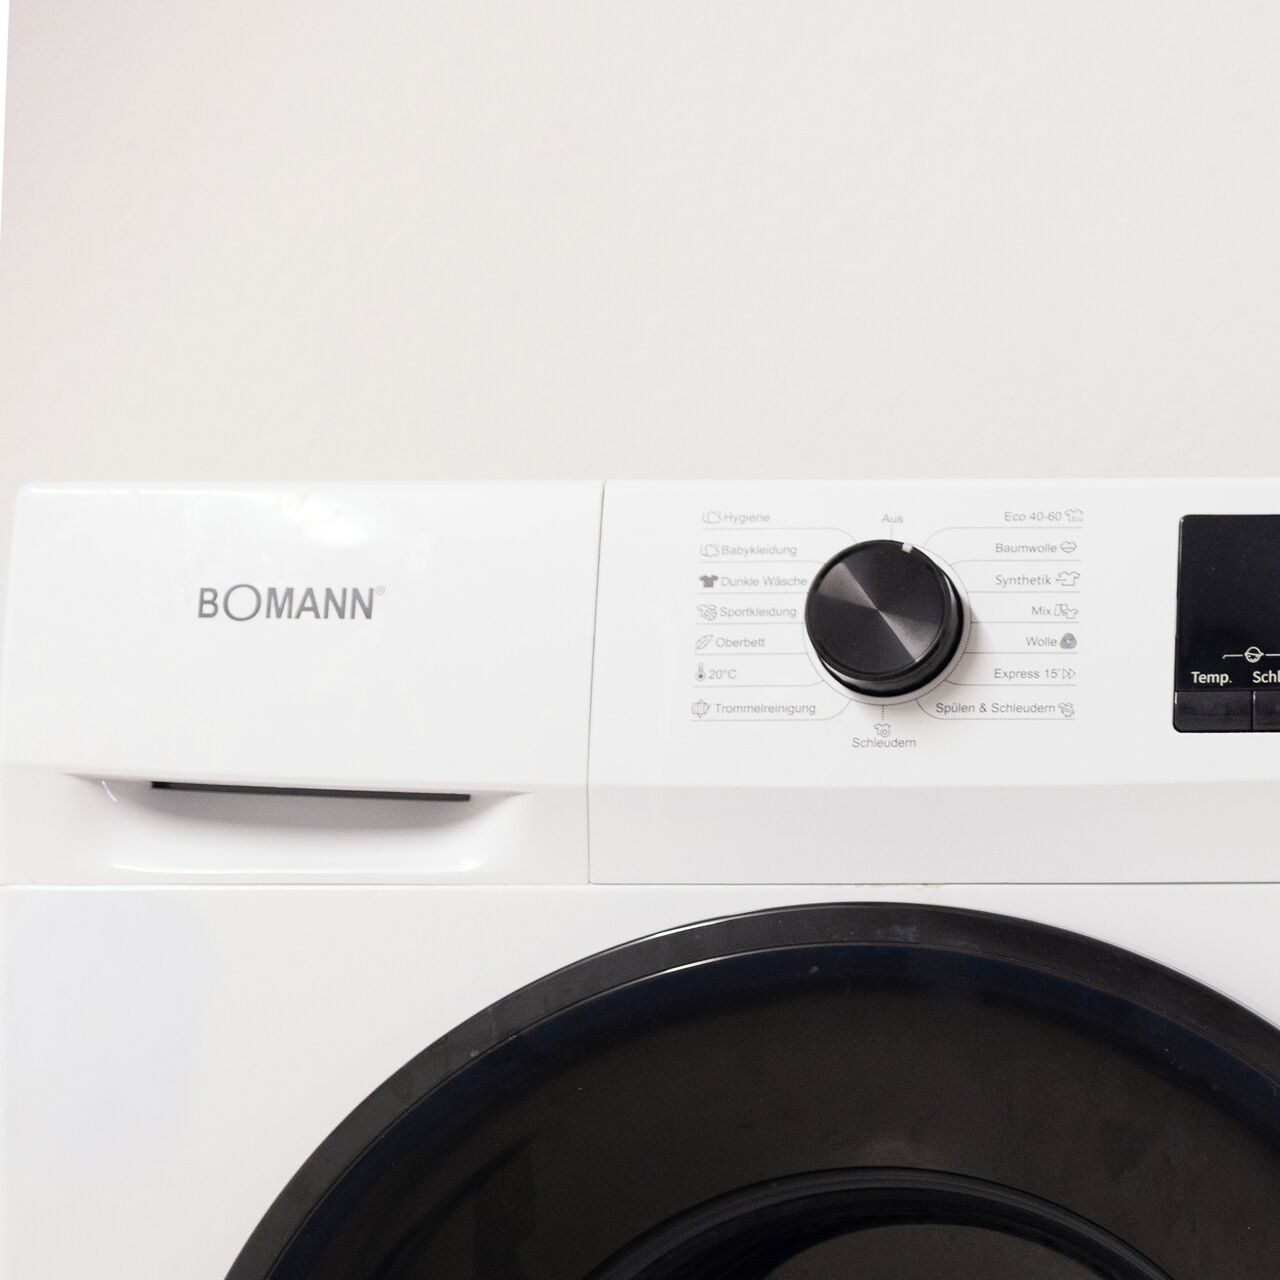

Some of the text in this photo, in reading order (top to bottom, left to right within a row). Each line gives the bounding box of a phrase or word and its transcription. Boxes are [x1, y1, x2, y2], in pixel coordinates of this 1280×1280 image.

[724, 512, 770, 524] Hygiene
[882, 513, 903, 524] Aus
[1004, 512, 1025, 522] Eco
[1029, 511, 1062, 522] 40-60
[721, 544, 798, 557] Babykleidung
[995, 542, 1057, 553] Baumwolle
[721, 575, 807, 587] Dunkle Wäsche
[995, 574, 1051, 586] Synthetik
[719, 606, 797, 618] Sportkleidung
[1031, 606, 1052, 616] Mix
[715, 637, 765, 648] Oberbett
[1026, 636, 1057, 647] Wolle
[709, 668, 737, 680] 20°C
[994, 668, 1039, 681] Express
[1191, 671, 1232, 686] Temp.
[716, 702, 816, 715] Trommelreinigung
[936, 702, 1056, 715] Spülen & Schleudern
[852, 737, 916, 748] Schleudern
